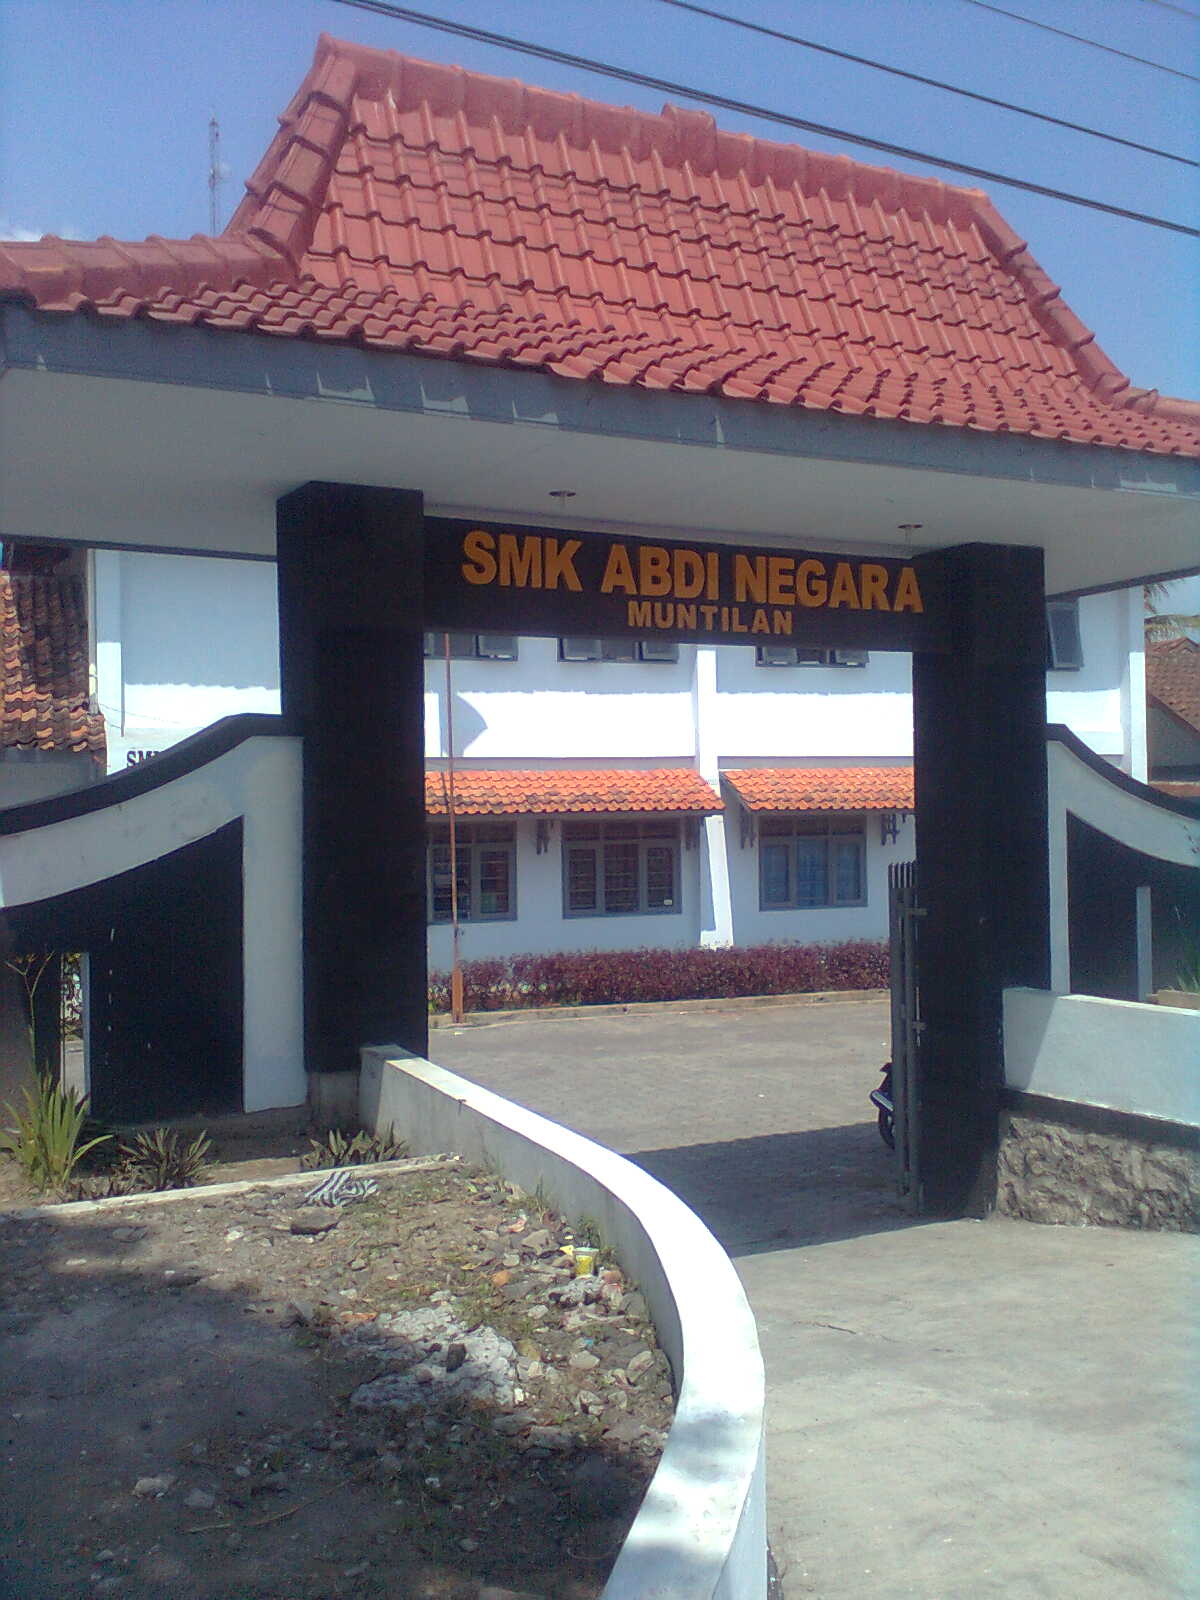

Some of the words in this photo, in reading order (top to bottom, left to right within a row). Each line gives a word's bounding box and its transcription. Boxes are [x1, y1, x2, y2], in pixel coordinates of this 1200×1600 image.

[462, 530, 582, 592] SMK
[601, 543, 720, 600] ABDI
[735, 555, 924, 613] NEGARA
[627, 601, 793, 635] MUNTILAN
[126, 750, 160, 768] SM
